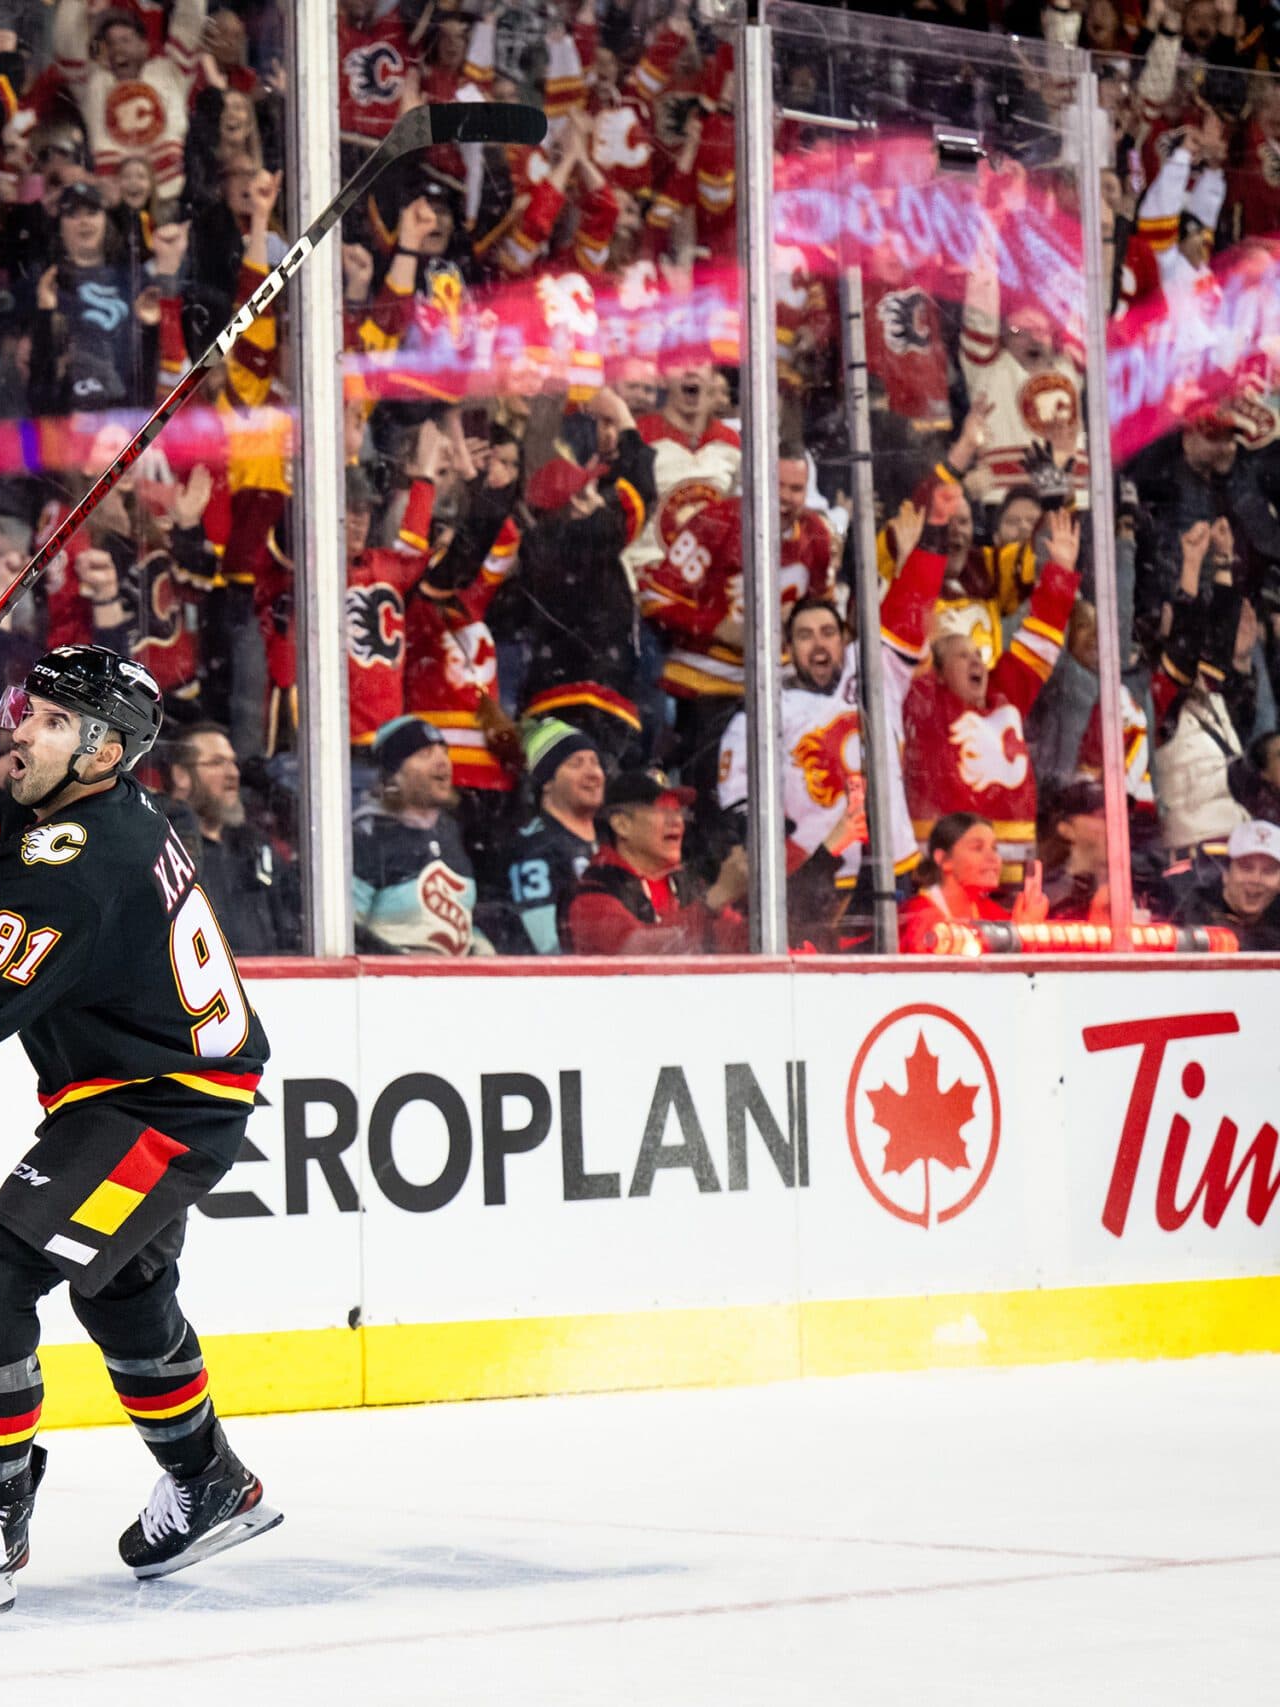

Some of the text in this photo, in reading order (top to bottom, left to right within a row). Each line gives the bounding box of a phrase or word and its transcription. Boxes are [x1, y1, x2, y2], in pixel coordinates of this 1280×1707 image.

[217, 236, 315, 355] CCM
[669, 530, 712, 584] 86
[34, 664, 61, 679] CCM
[508, 858, 552, 902] 13
[170, 883, 250, 1057] 9
[208, 1488, 238, 1527] CCM
